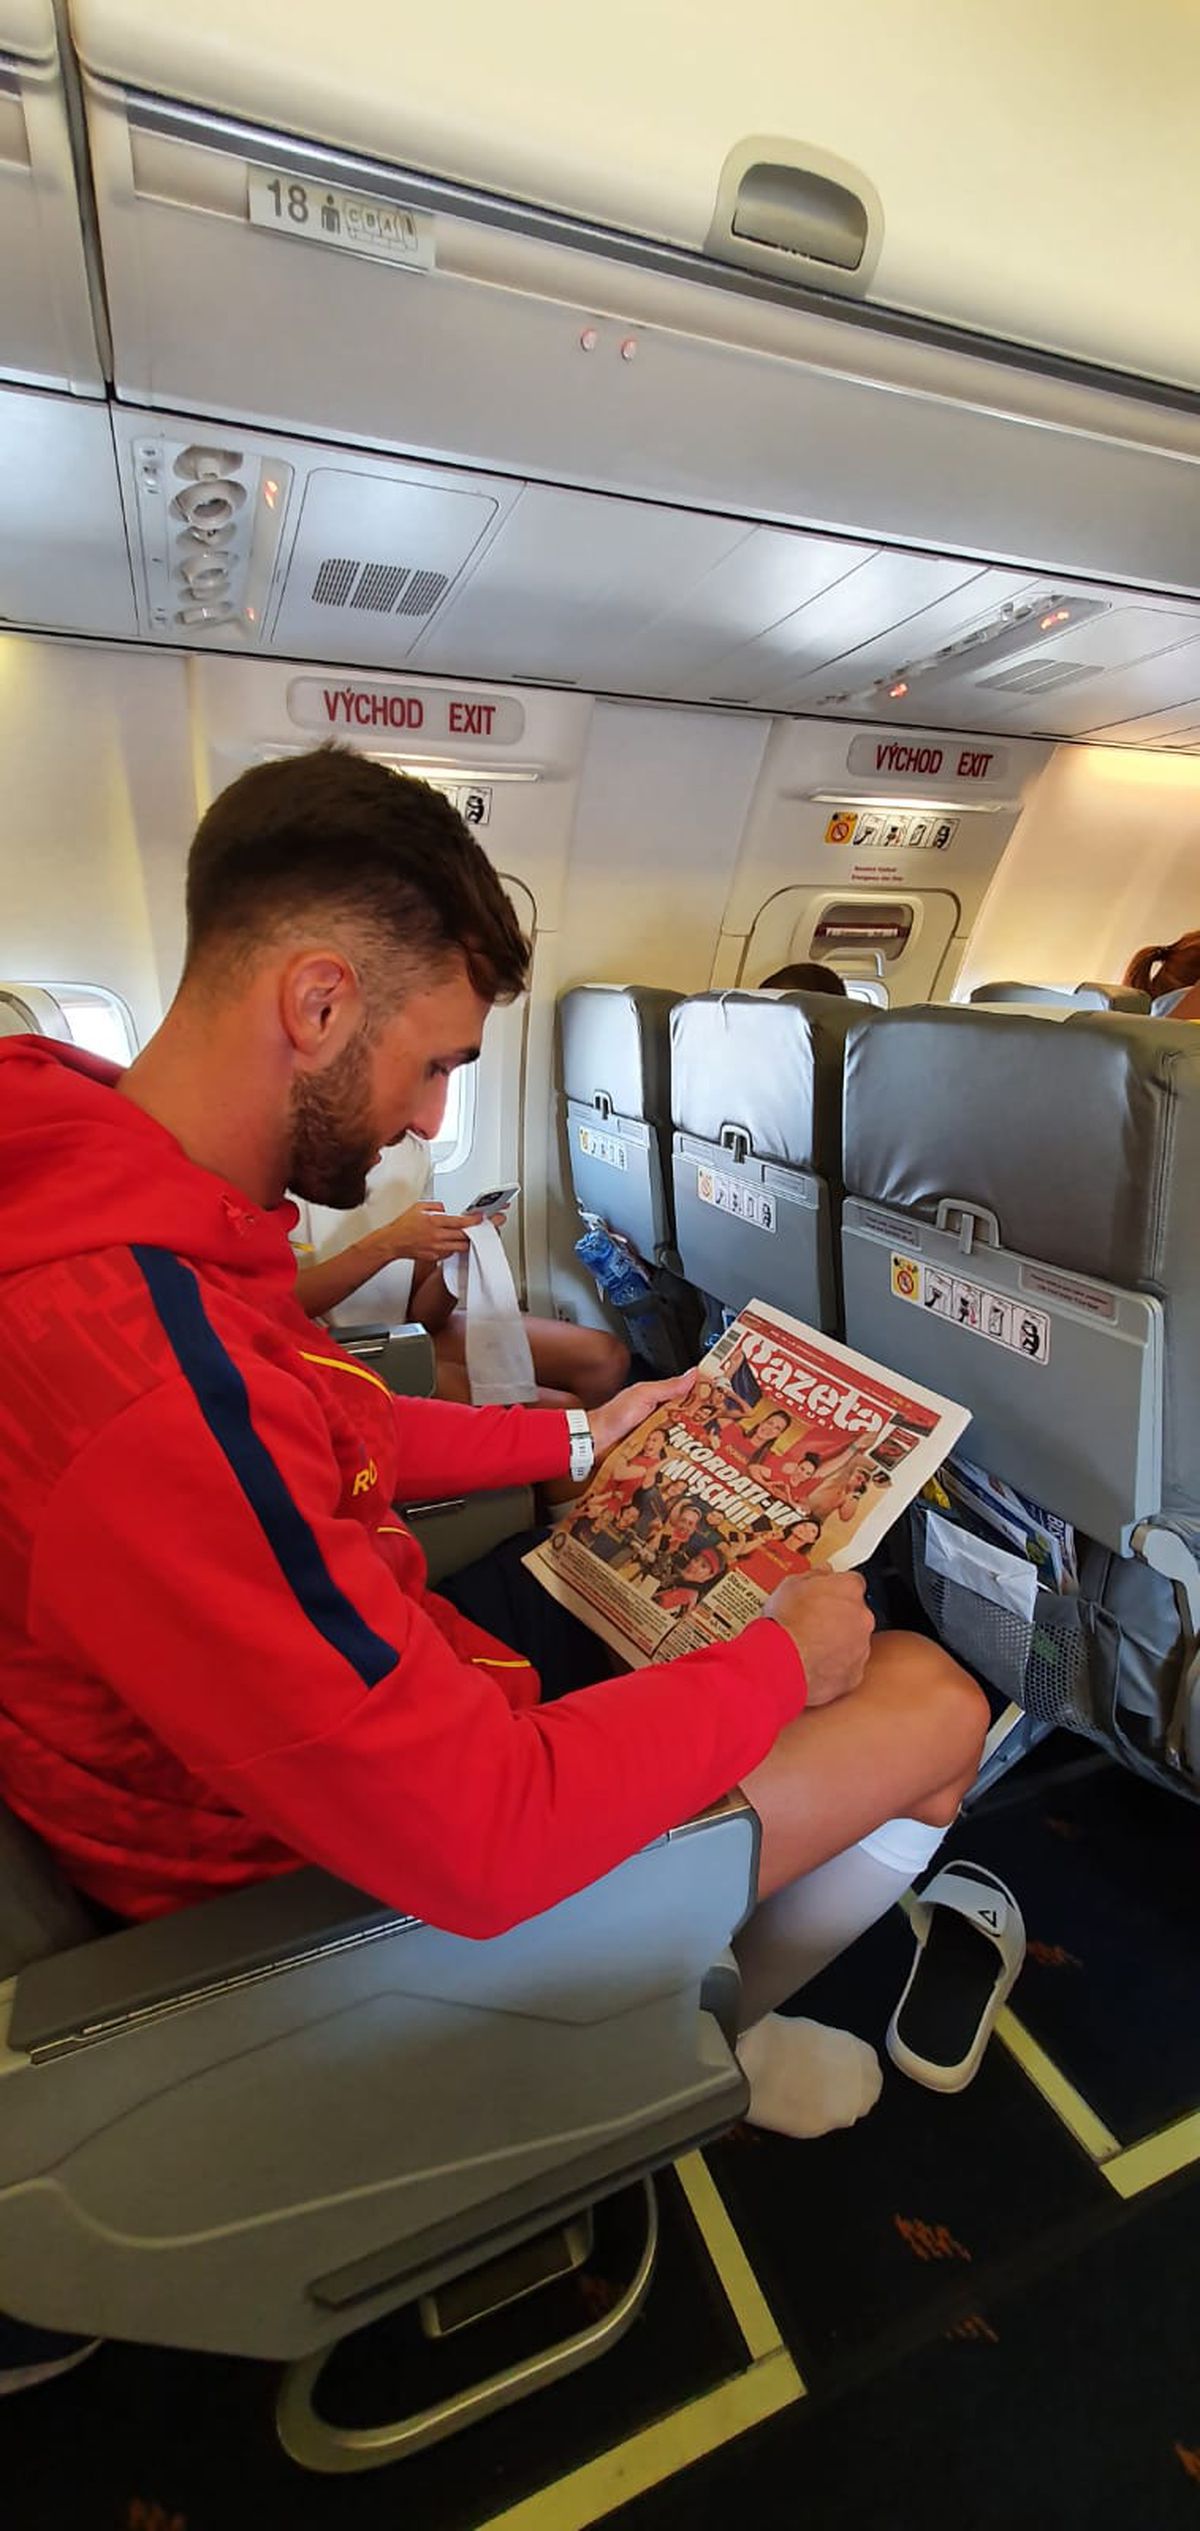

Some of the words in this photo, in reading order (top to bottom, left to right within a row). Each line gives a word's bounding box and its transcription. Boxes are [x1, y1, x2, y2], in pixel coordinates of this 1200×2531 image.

[267, 179, 309, 223] 18
[324, 687, 424, 729] VÝCHOD
[449, 702, 496, 735] EXIT
[876, 742, 943, 774] VÝCHOD
[957, 752, 993, 778] EXIT
